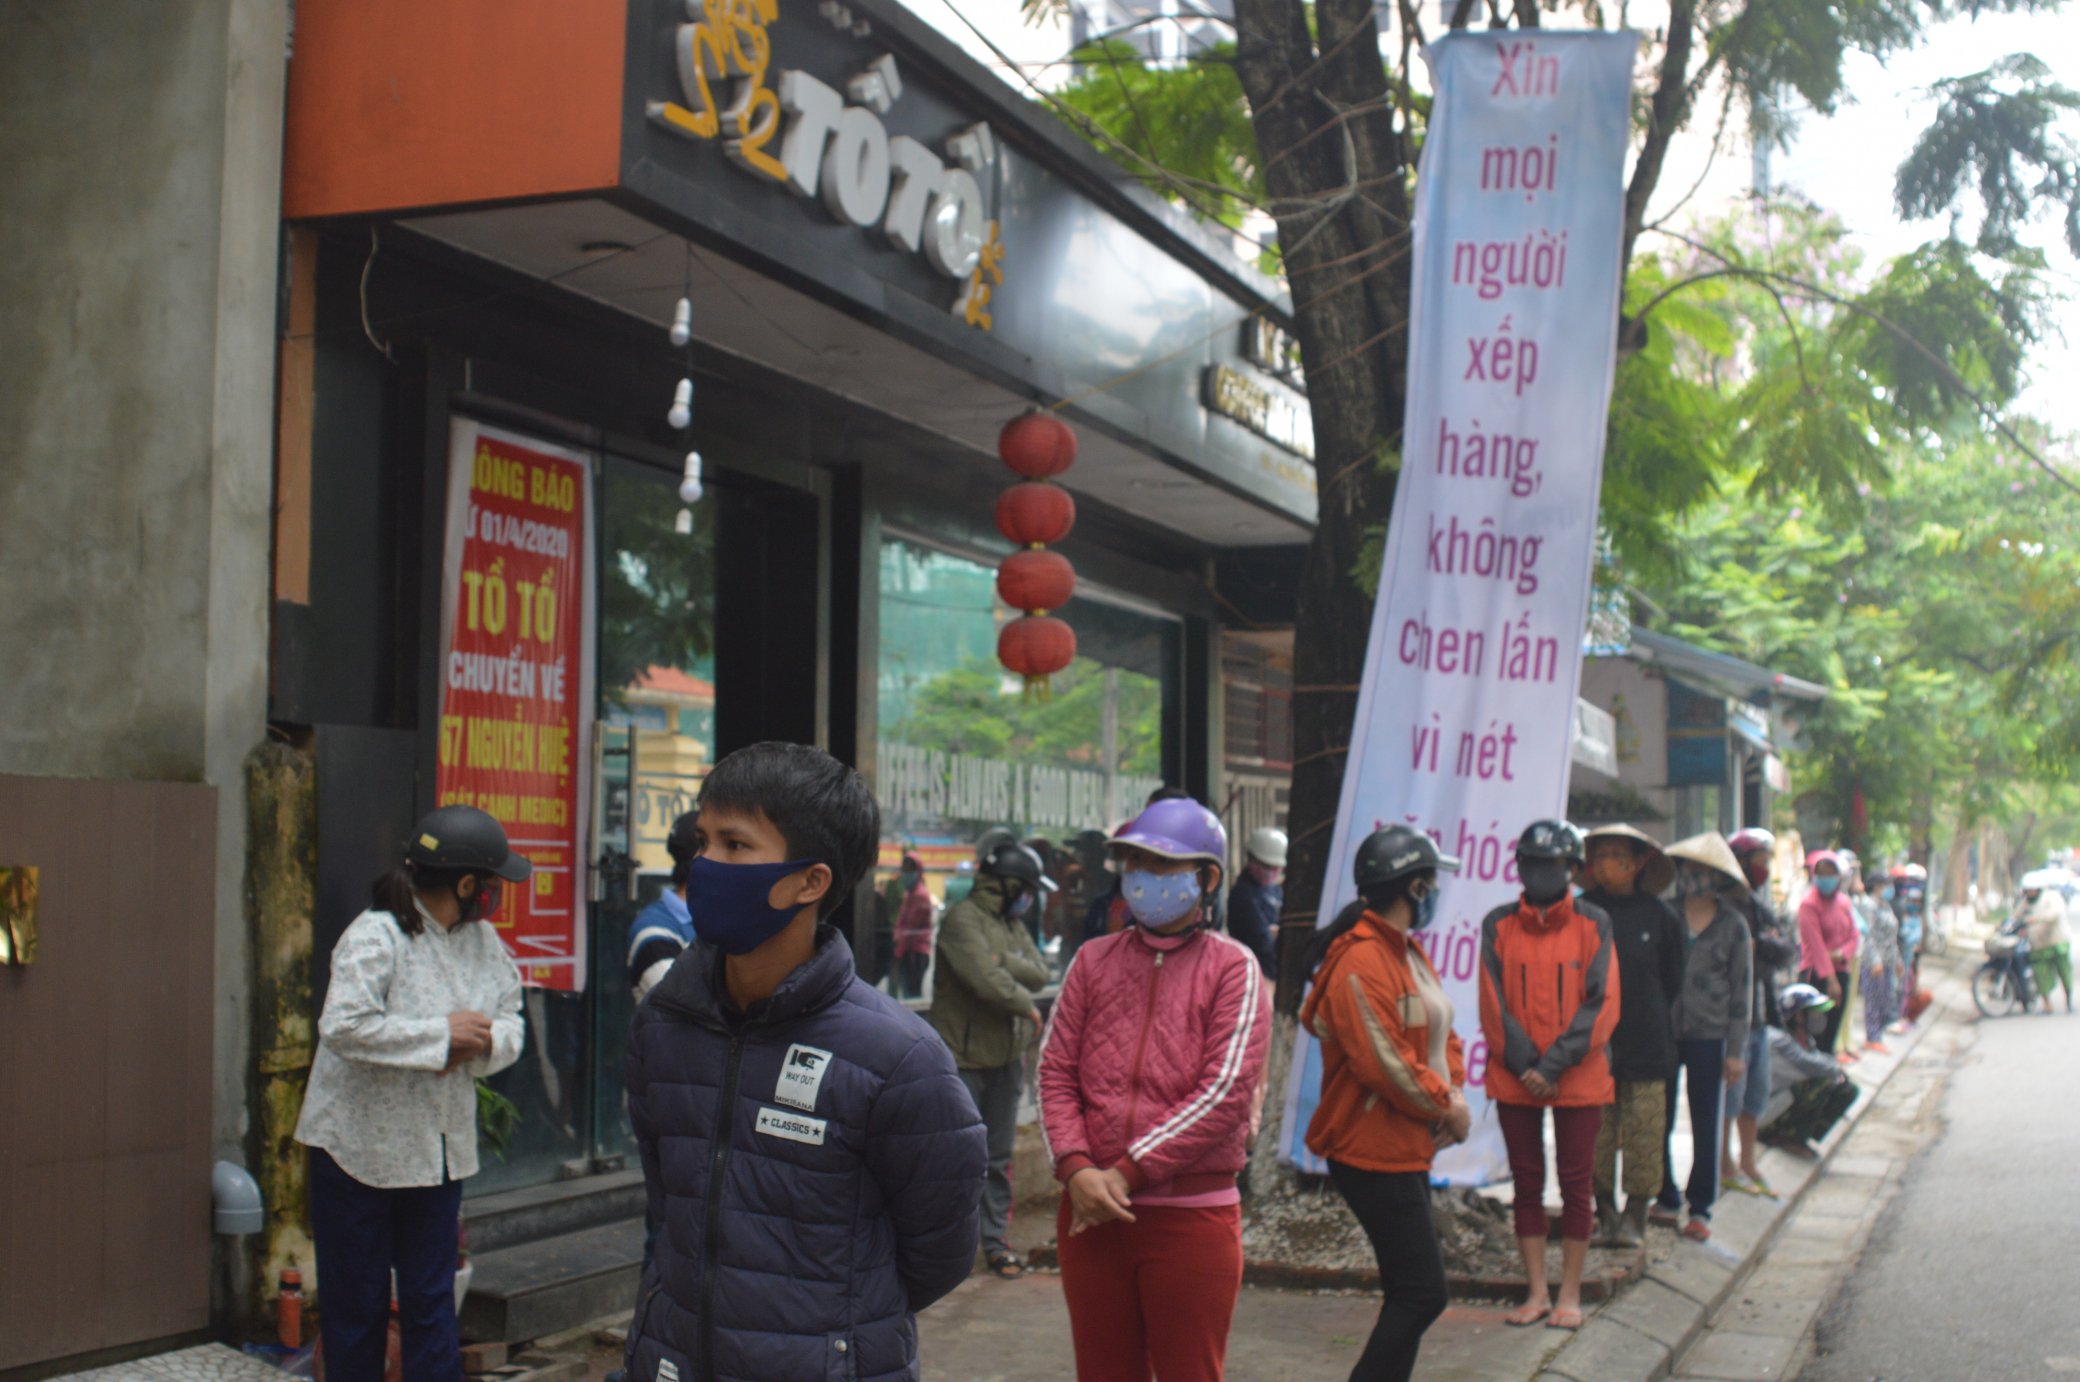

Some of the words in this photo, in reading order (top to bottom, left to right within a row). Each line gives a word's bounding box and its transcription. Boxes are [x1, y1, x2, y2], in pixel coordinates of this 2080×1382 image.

[1491, 41, 1560, 97] Xin
[1480, 132, 1558, 202] mọi
[1452, 227, 1569, 300] người
[1464, 313, 1539, 397] xếp
[1436, 416, 1543, 498] hàng,
[481, 509, 569, 559] 01/4/2020
[1427, 512, 1545, 596] không
[1398, 609, 1485, 677] chen
[1497, 610, 1560, 683] lấn
[440, 714, 463, 768] 67
[1411, 712, 1441, 773] vì
[1455, 719, 1518, 782] nét
[785, 1071, 800, 1081] WAY
[800, 1074, 816, 1086] OUT
[770, 1118, 810, 1135] CLASSICS
